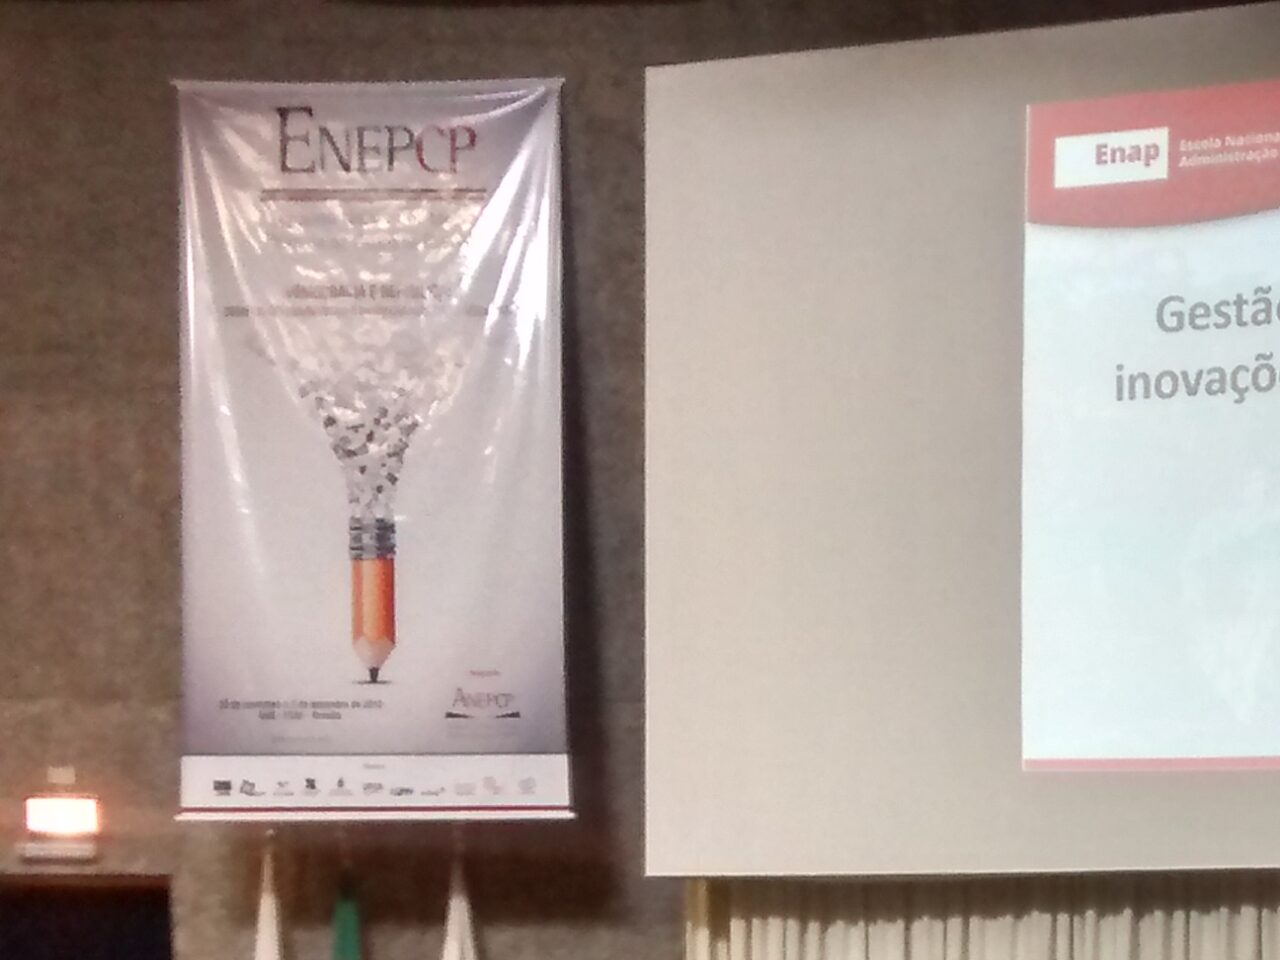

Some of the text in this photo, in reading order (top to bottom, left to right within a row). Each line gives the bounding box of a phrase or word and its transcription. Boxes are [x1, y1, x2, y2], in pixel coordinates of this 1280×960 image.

[275, 106, 477, 174] ENEPCP
[1180, 137, 1221, 151] Escola
[1095, 142, 1160, 167] Enap
